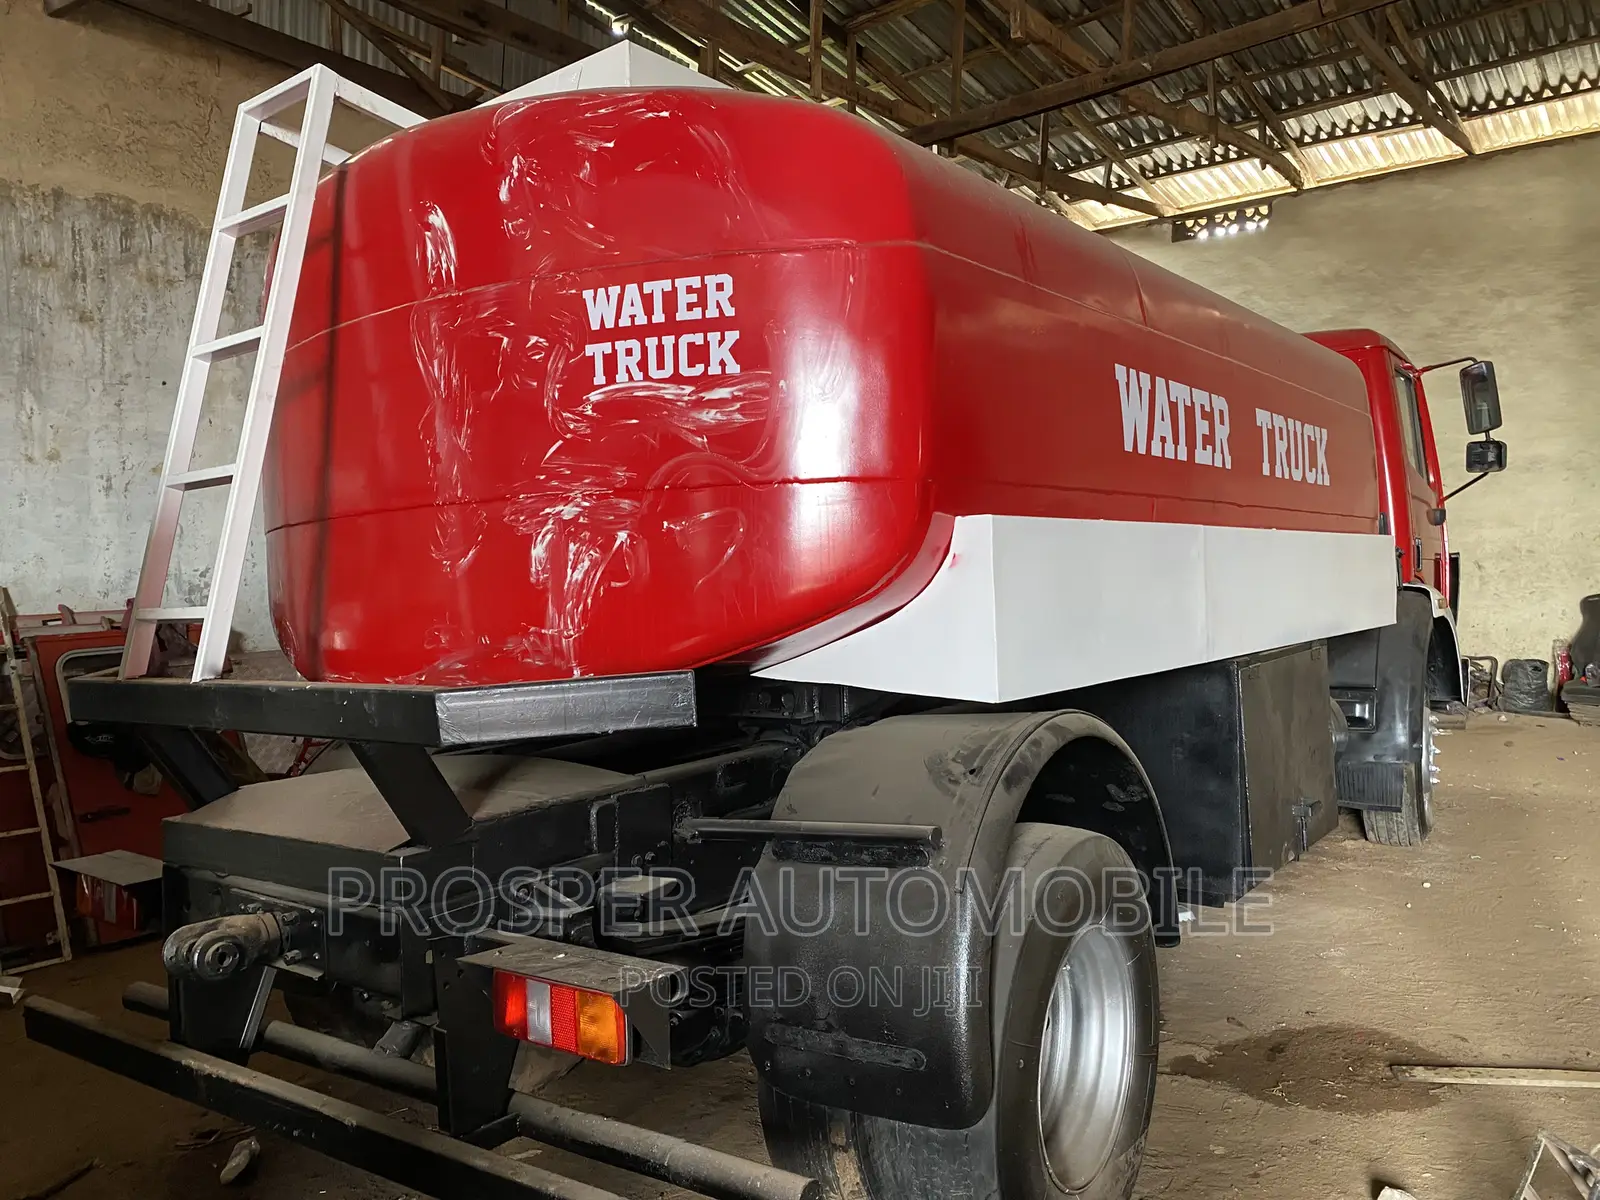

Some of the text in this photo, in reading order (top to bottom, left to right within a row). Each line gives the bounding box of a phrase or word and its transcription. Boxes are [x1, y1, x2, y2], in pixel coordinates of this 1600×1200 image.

[582, 273, 735, 331] WATER
[585, 330, 741, 385] TRUCK
[1114, 363, 1330, 486] WATER TRUCK
